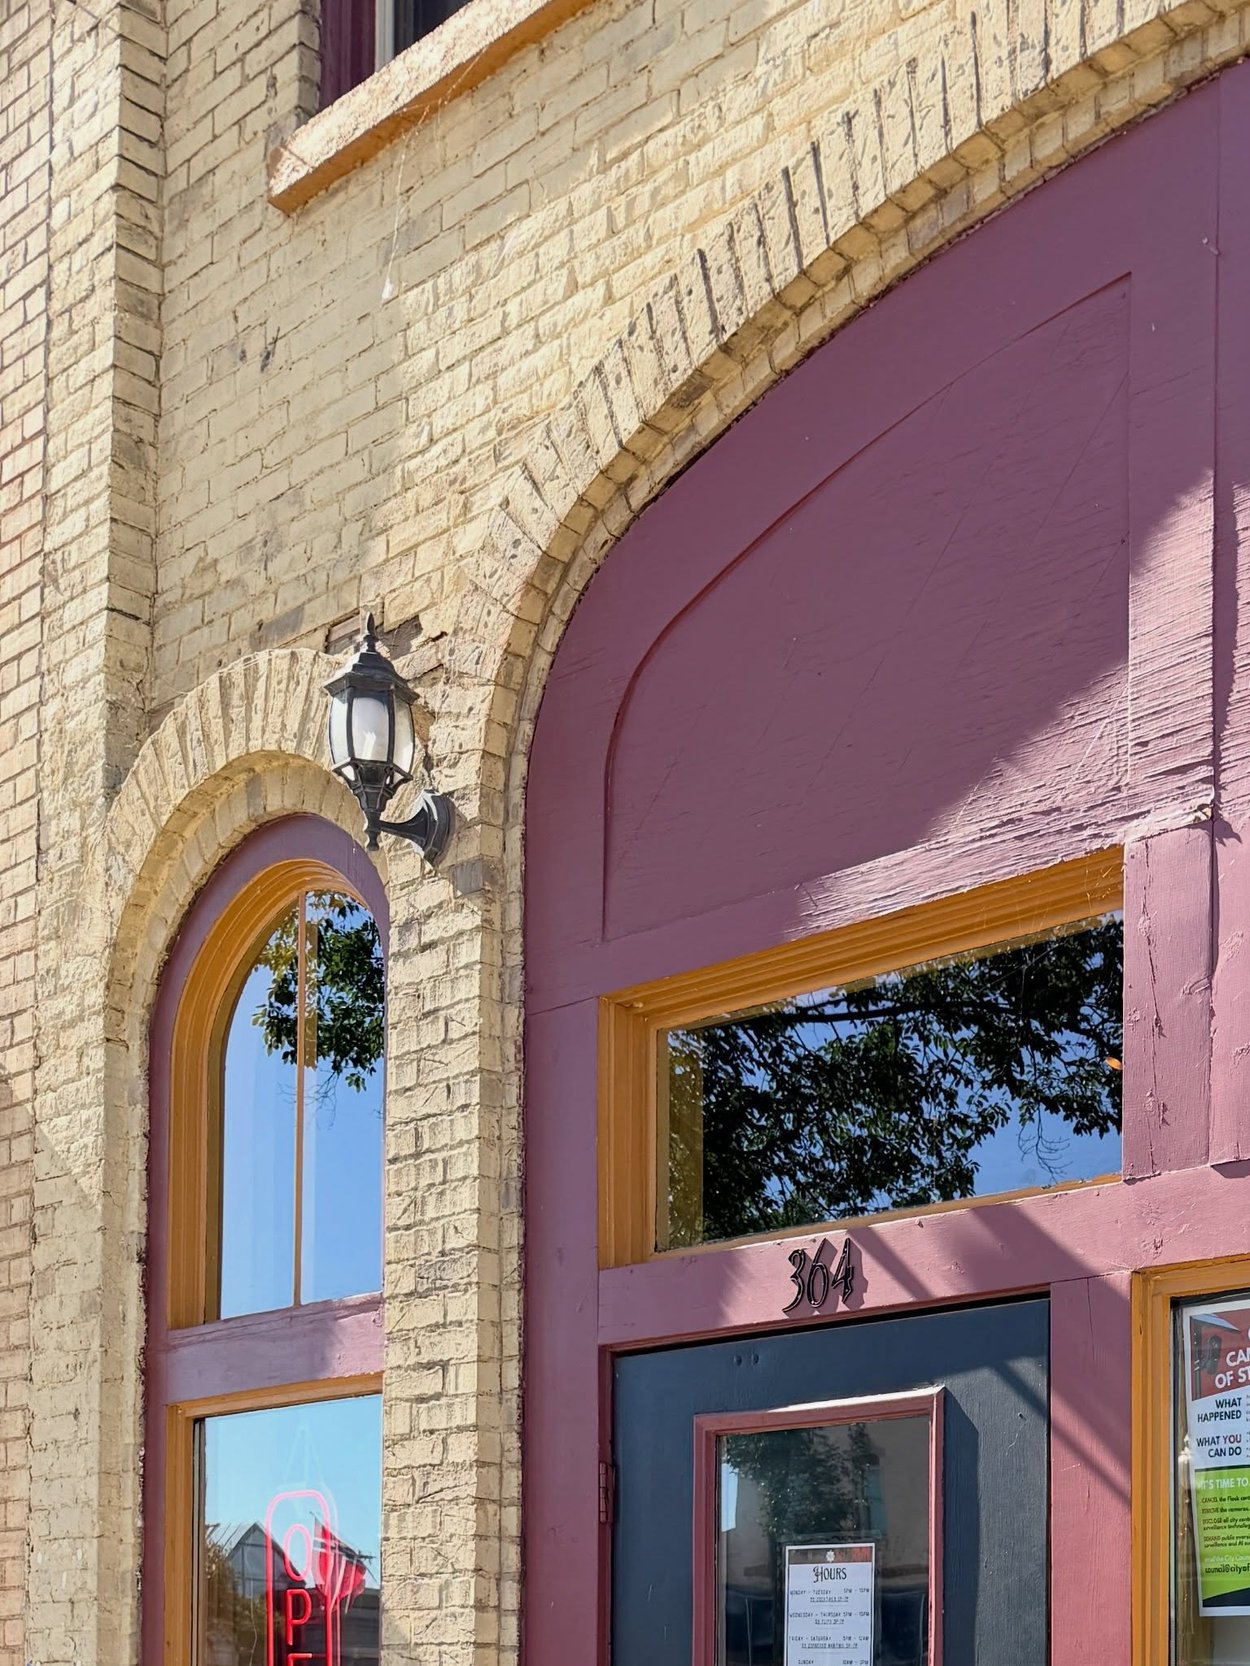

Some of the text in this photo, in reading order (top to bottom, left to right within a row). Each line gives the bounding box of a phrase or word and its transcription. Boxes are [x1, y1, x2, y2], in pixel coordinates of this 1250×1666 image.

[782, 1238, 854, 1308] 364
[1215, 1371, 1235, 1389] OF
[1215, 1397, 1242, 1409] WHAT
[1197, 1409, 1242, 1423] HAPPENED
[1196, 1434, 1242, 1447] WHAT YOU
[1208, 1446, 1242, 1458] CAN DO
[1215, 1478, 1235, 1488] TIME
